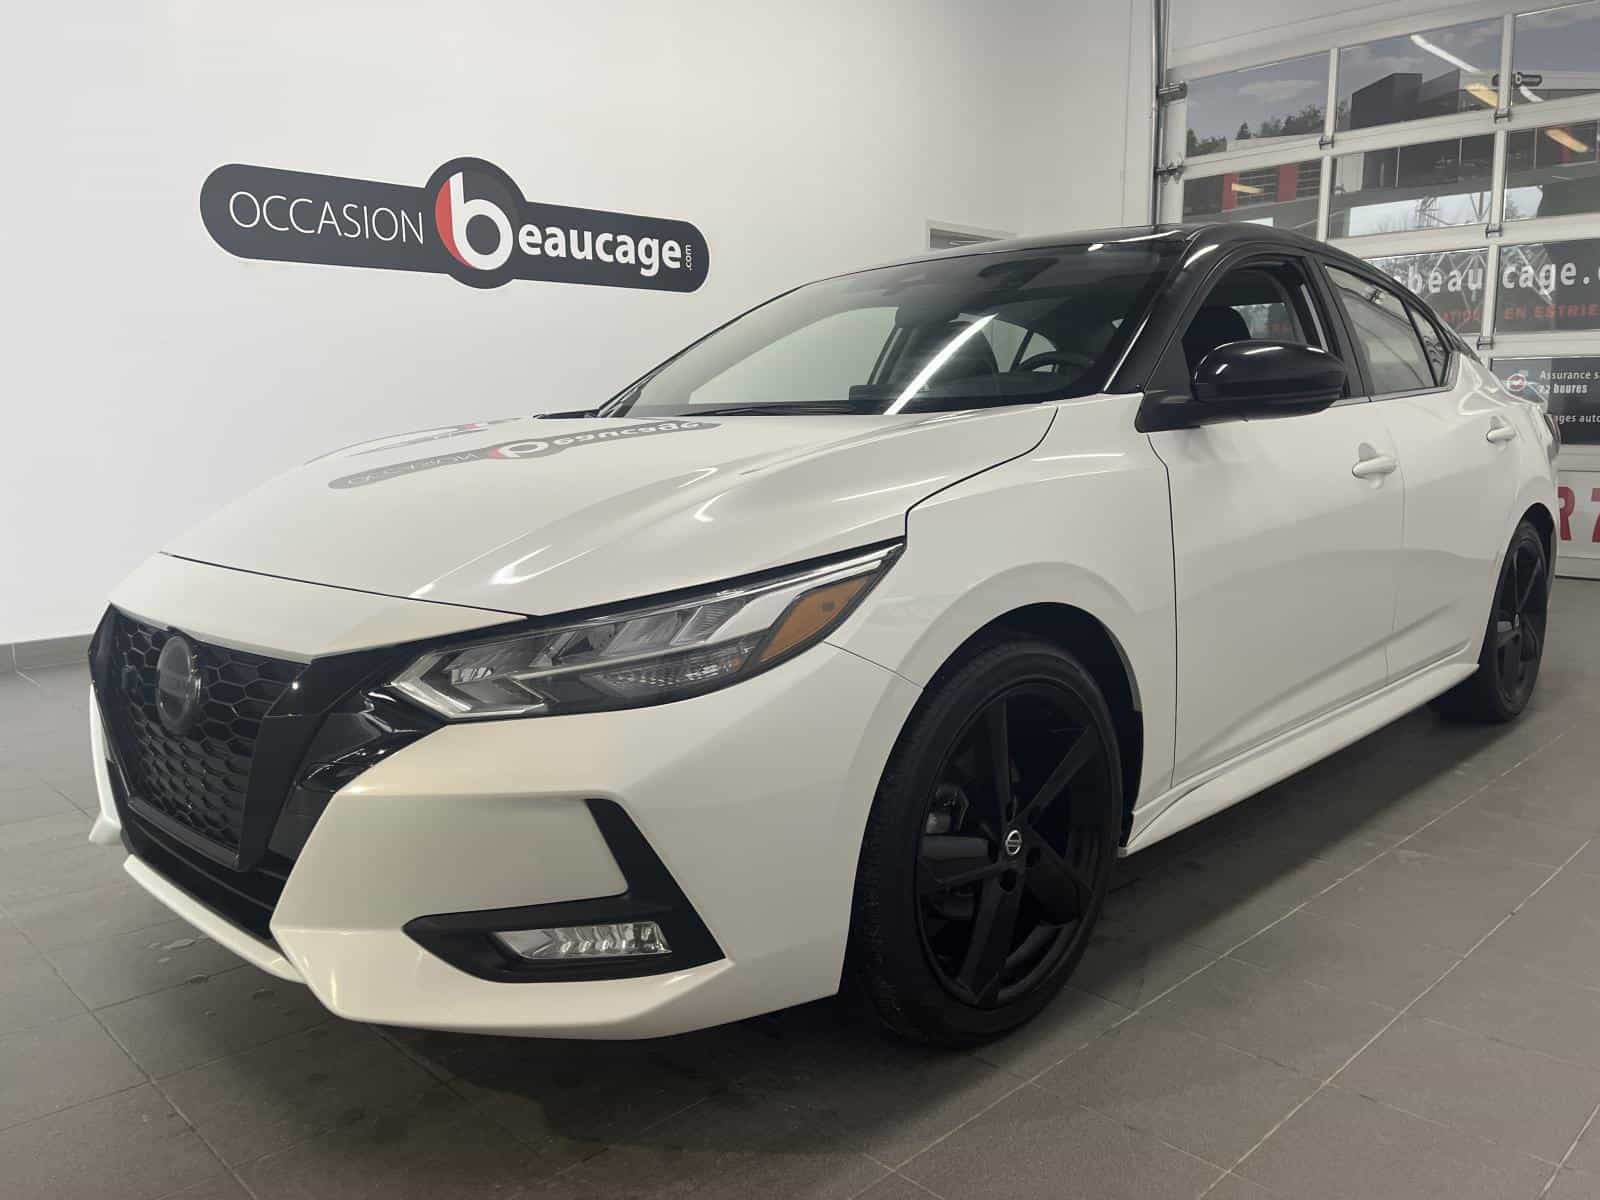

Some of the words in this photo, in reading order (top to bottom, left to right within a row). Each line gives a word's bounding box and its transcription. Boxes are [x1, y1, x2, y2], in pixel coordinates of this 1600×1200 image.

[229, 191, 424, 245] OCCASION
[1502, 261, 1600, 295] cage.
[1540, 370, 1592, 380] Assurance
